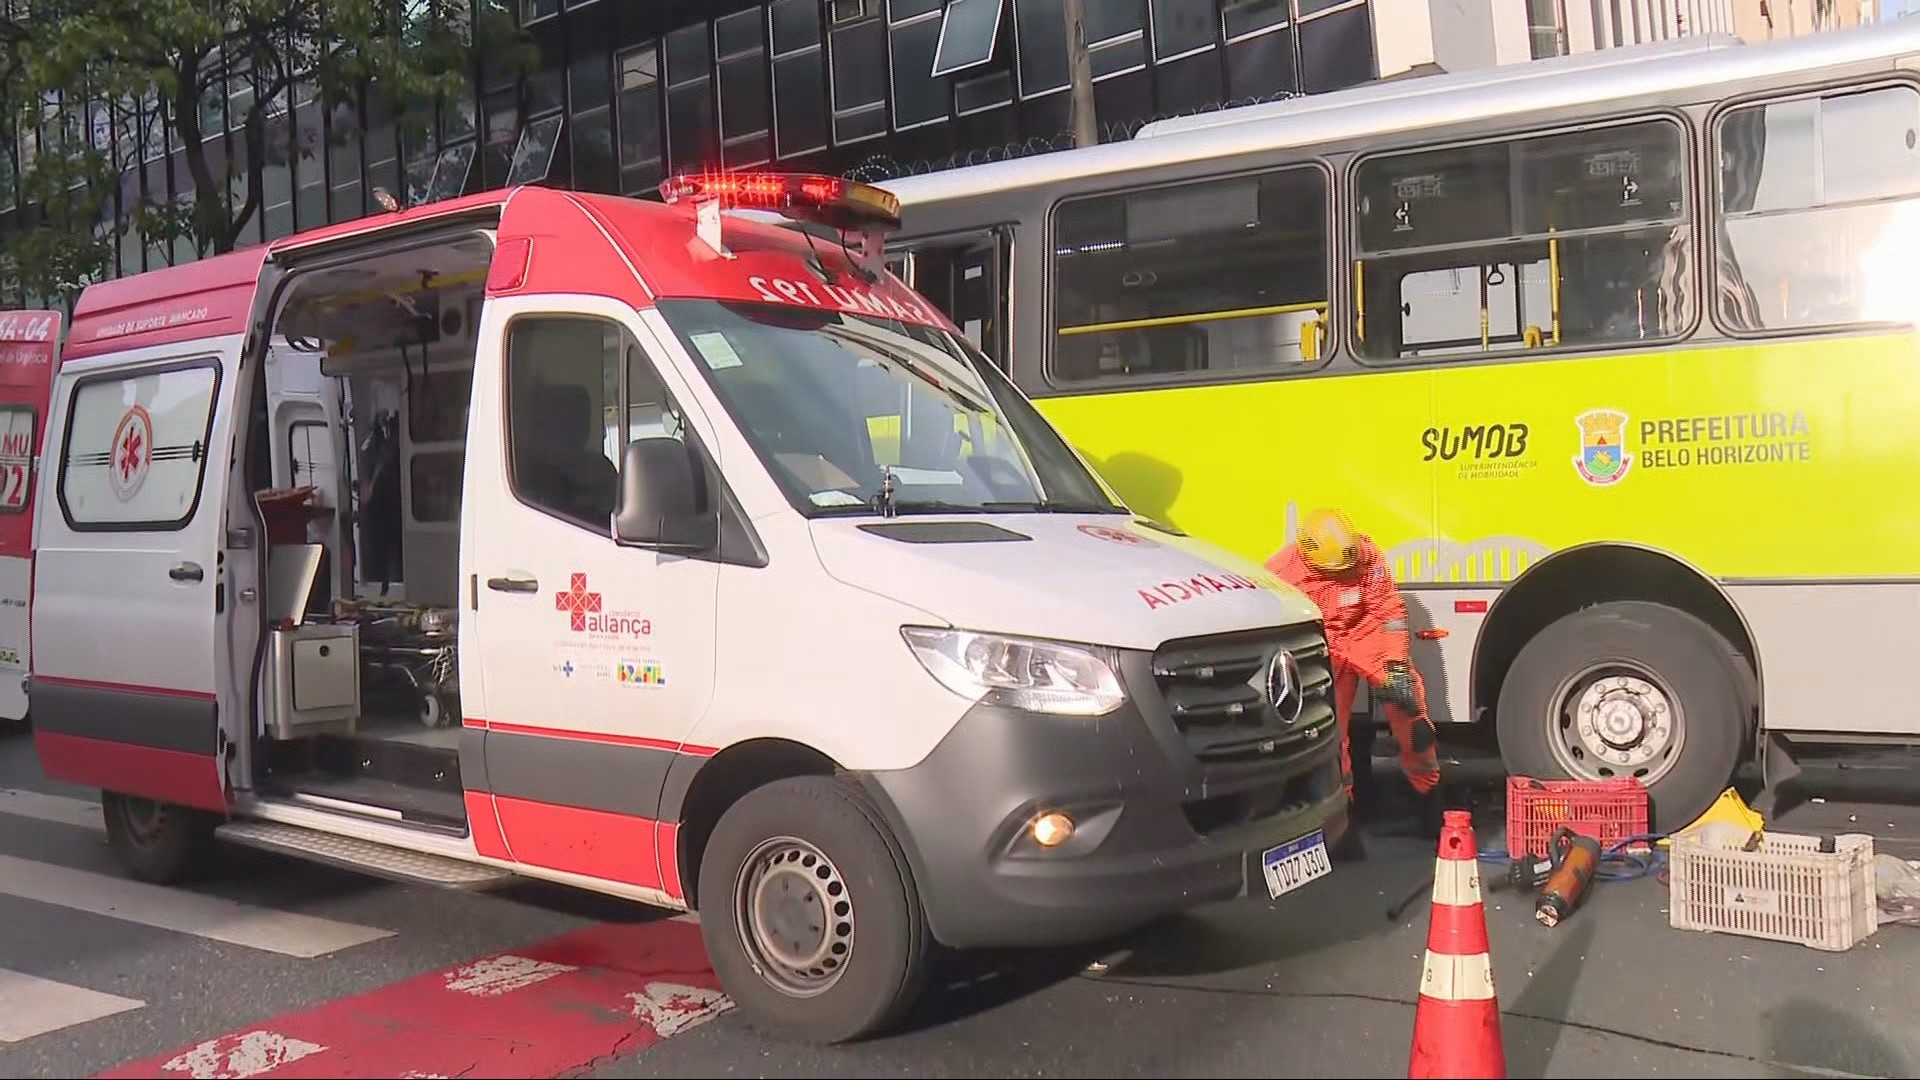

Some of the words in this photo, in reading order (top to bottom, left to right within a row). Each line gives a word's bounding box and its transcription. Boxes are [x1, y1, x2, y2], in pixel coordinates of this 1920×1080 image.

[1640, 409, 1809, 445] PREFEITURA
[1421, 423, 1529, 462] SUMOB
[1641, 448, 1690, 469] BELO
[1696, 442, 1811, 466] HORIZONTE
[1470, 470, 1519, 479] MOBILIDADE
[588, 614, 651, 639] aliança
